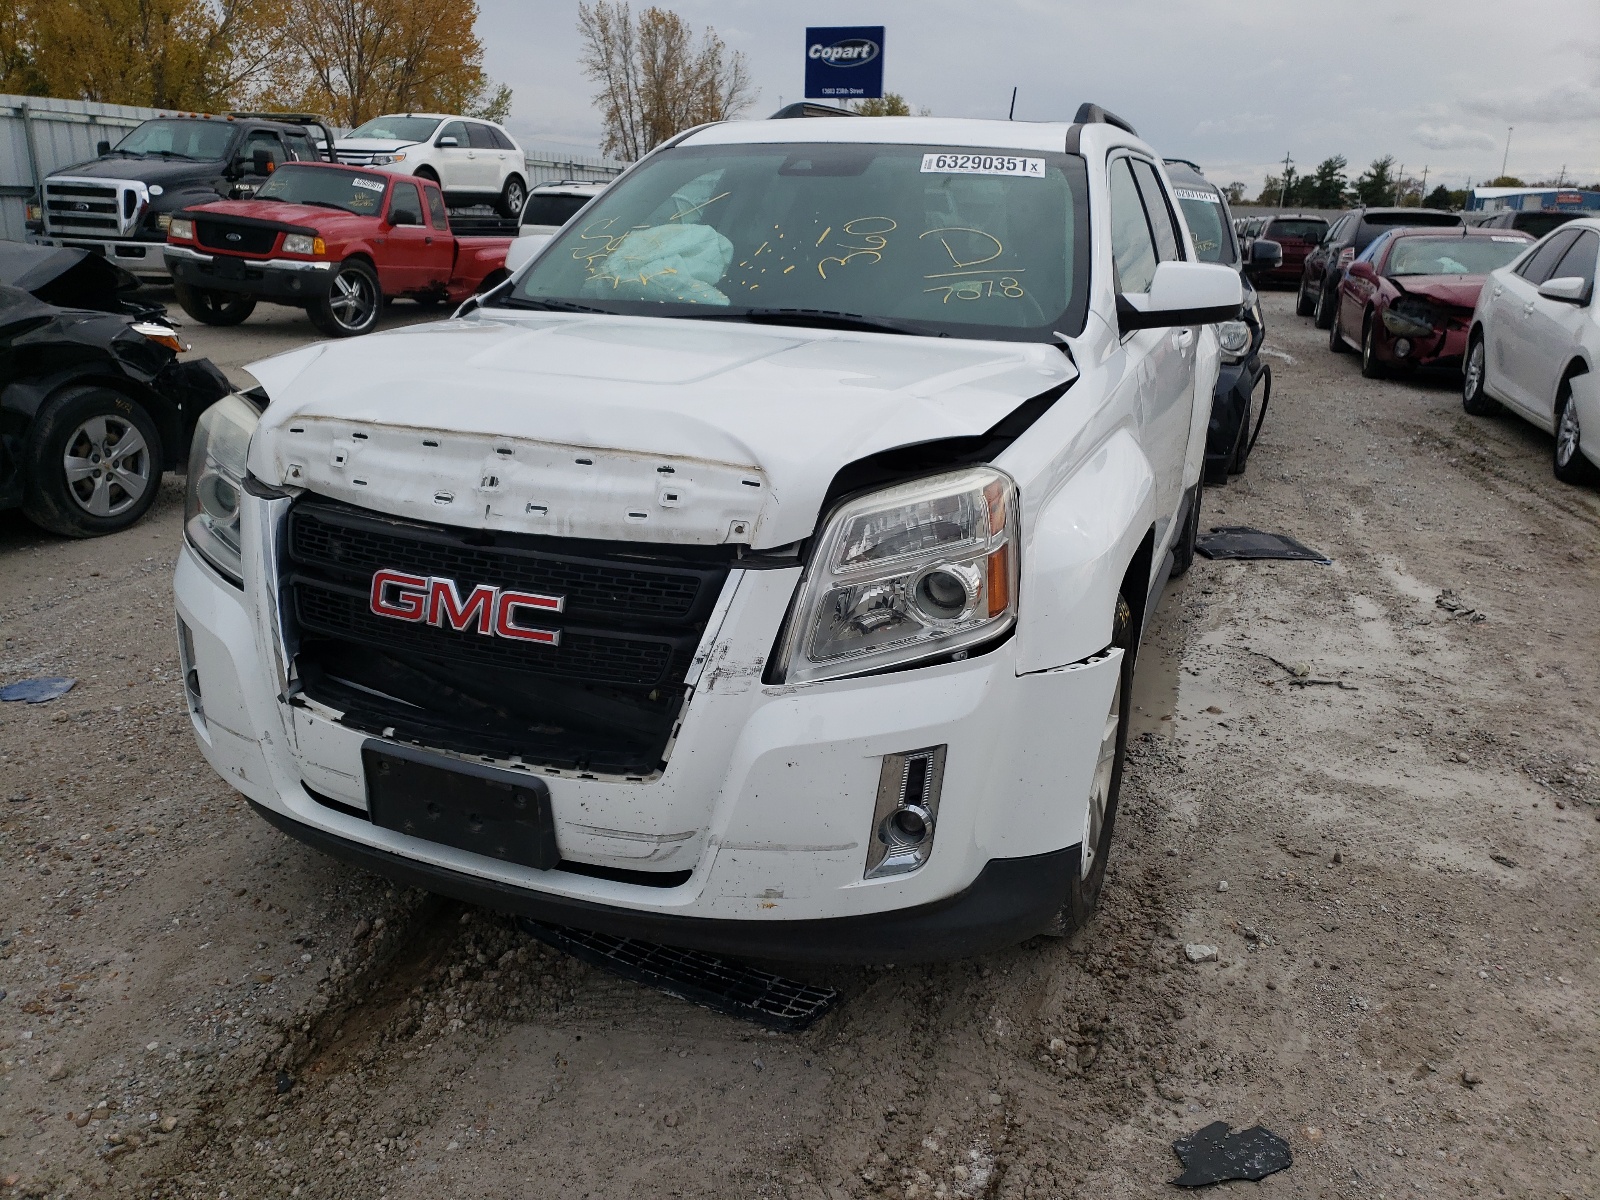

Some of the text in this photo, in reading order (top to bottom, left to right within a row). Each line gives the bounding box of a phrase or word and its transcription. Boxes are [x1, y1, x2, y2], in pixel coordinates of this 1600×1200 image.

[808, 43, 871, 62] Copart
[850, 87, 864, 95] Street
[935, 154, 1028, 172] 63290351
[369, 568, 567, 647] GMC
